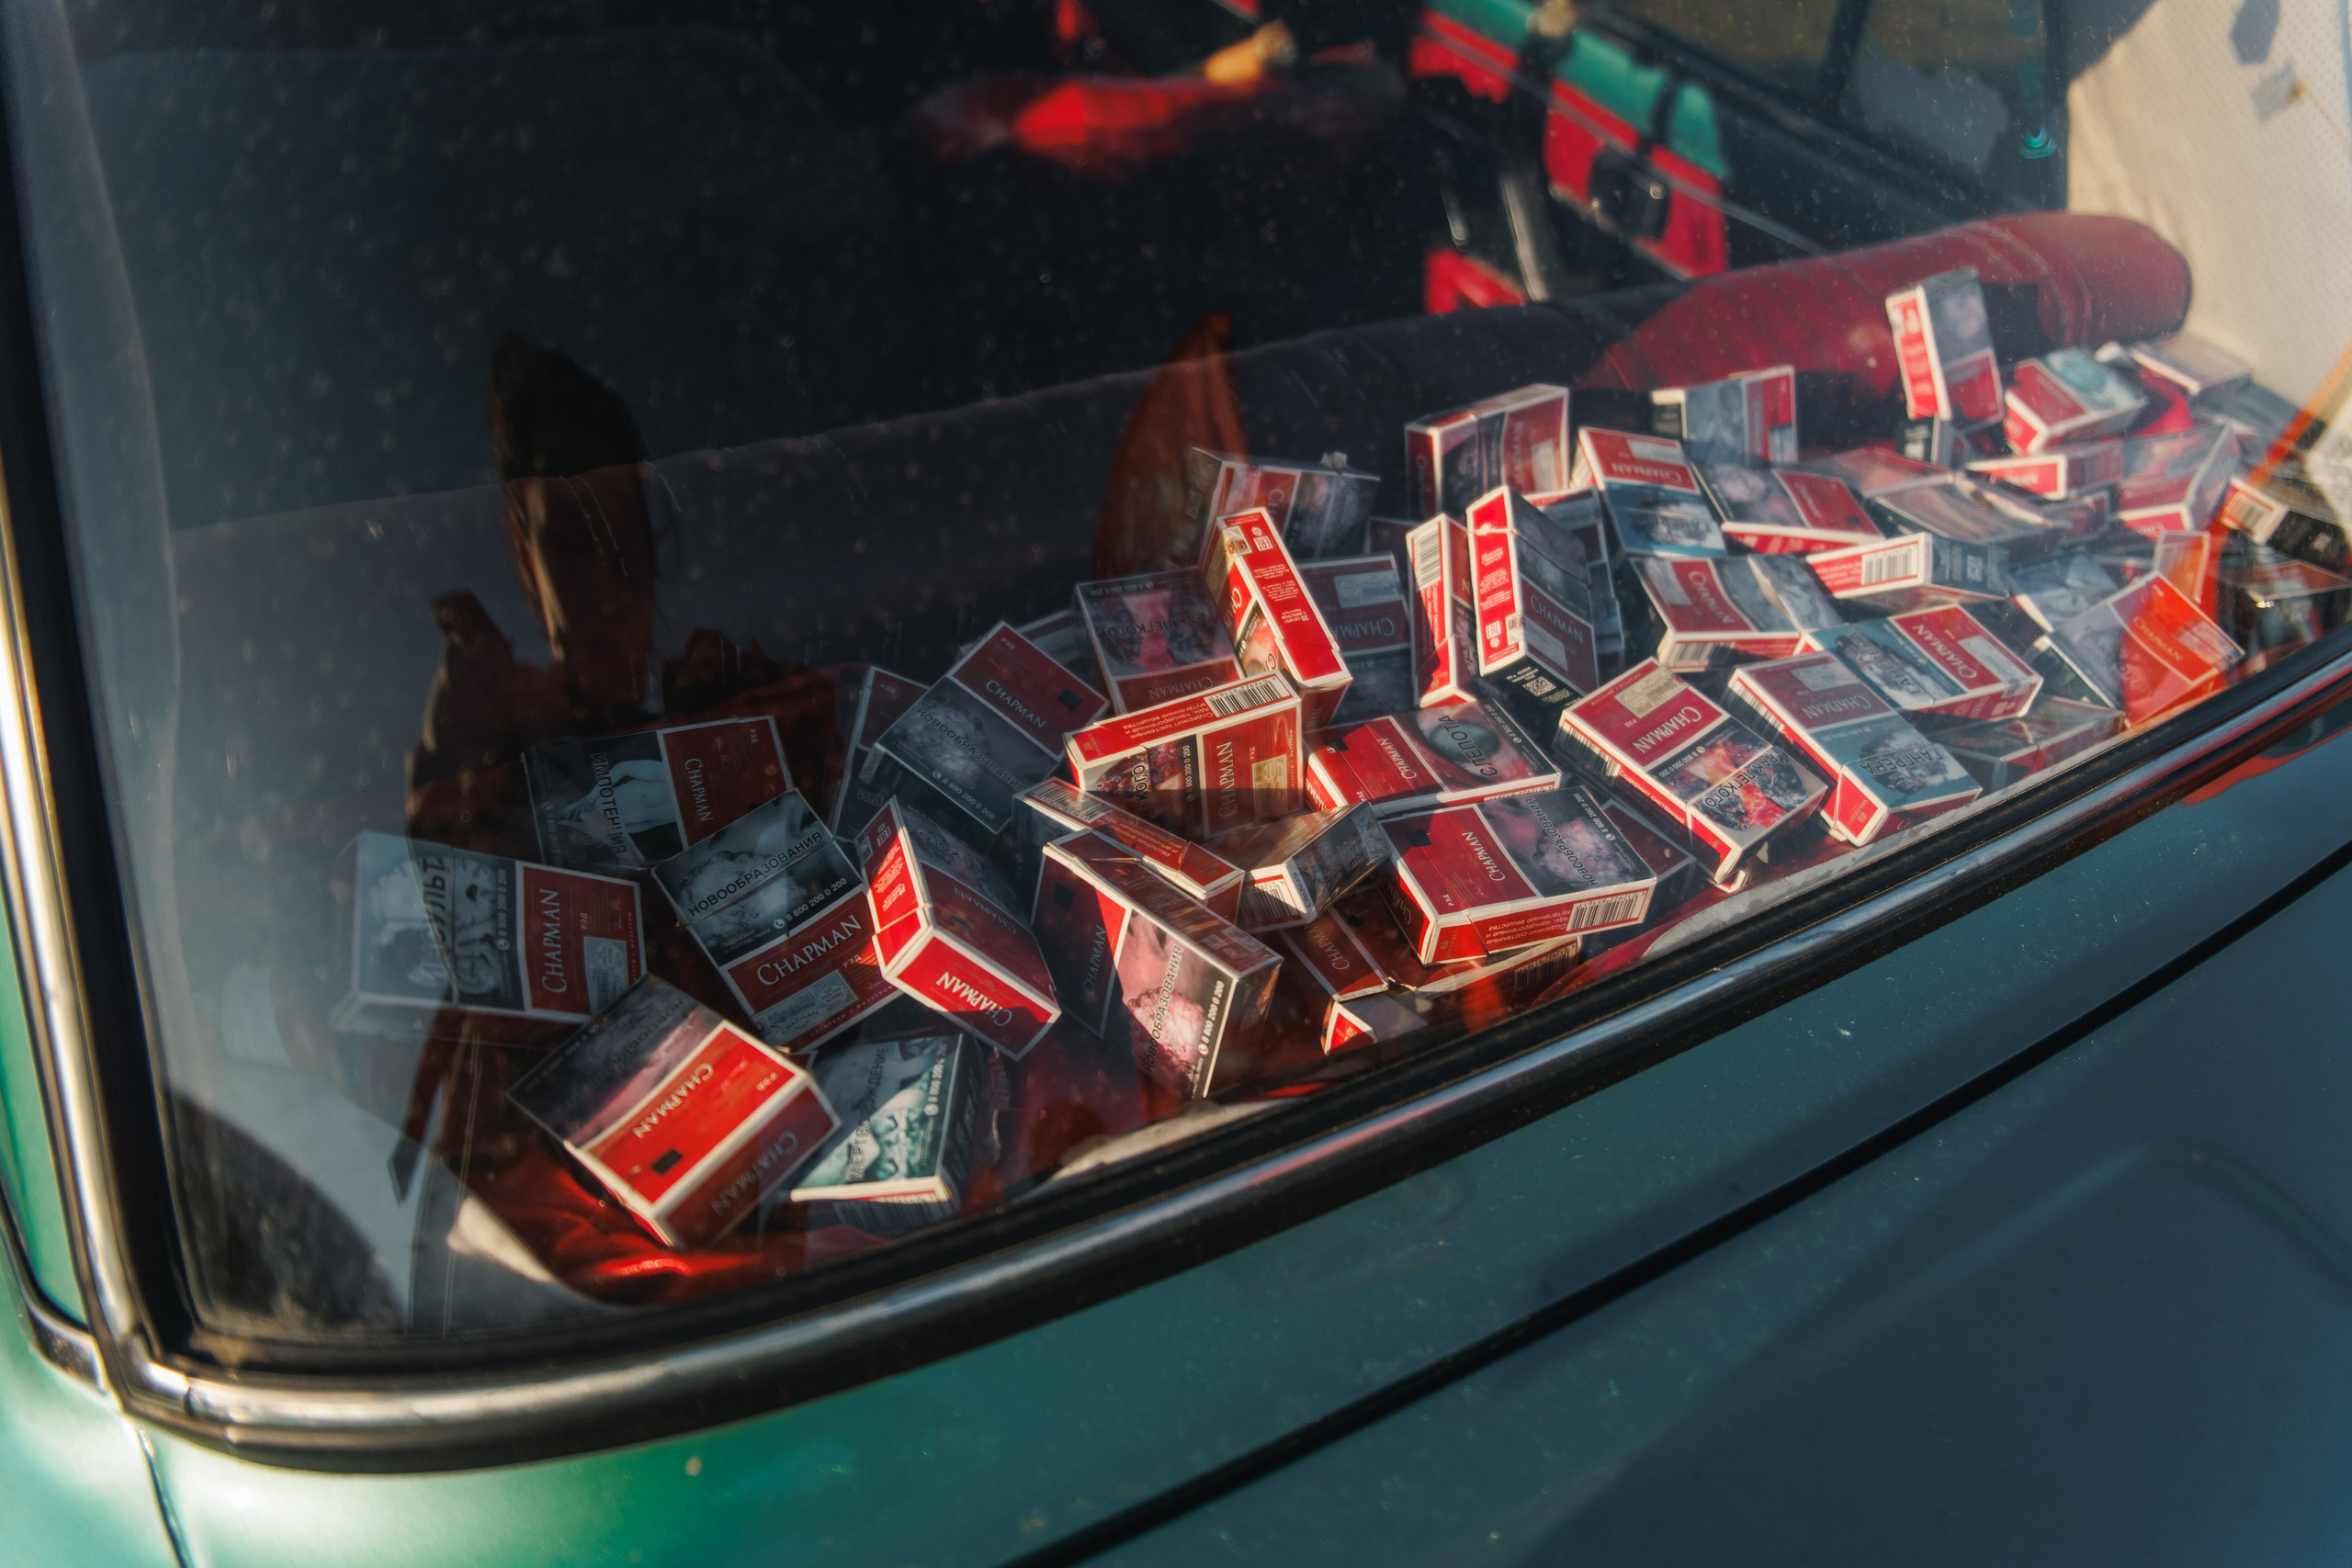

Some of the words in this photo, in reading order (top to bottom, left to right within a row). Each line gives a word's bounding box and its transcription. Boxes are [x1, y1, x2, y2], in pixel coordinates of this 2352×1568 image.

[1611, 462, 1682, 484] CHAPMAN
[1254, 536, 1272, 551] EAC
[1108, 618, 1176, 637] ЛЕГКОГО
[1327, 615, 1396, 645] CHAPMA
[1530, 594, 1584, 644] CHAPMAN
[1001, 637, 1016, 650] РЭД
[1912, 624, 1978, 680] CHAPMAN
[1148, 676, 1214, 700] CHAPMAN
[985, 680, 1048, 729] CHAPMAN
[1159, 700, 1206, 717] мутагенные
[1190, 705, 1210, 716] яды,
[1801, 694, 1872, 720] CHAPMAN
[1121, 715, 1161, 730] вещества
[1128, 711, 1191, 734] канцерогенные
[1170, 709, 1214, 726] Содержит
[1623, 718, 1638, 728] РЭД
[749, 728, 760, 743] РЭД
[1128, 723, 1173, 739] системные
[1632, 705, 1702, 754] CHAPMAN
[915, 707, 1027, 791] НОВООБРАЗОВАНИЯ
[1438, 715, 1498, 778] СЛЕПОТА
[1377, 737, 1419, 781] CHAPMAN
[1668, 764, 1674, 773] 0
[1672, 759, 1685, 770] 200
[1683, 753, 1696, 764] 800
[1757, 753, 1779, 773] РАК
[1860, 748, 1944, 776] ГАНГРЕНА
[1216, 741, 1238, 818] CHAPMAN
[1657, 767, 1669, 778] 200
[684, 758, 713, 823] CHAPMAN
[941, 775, 949, 784] 8
[948, 780, 963, 795] 800
[962, 790, 978, 806] 200
[976, 800, 983, 809] 0
[980, 804, 997, 820] 200
[1572, 792, 1584, 806] 200
[1617, 768, 1652, 798] Содержит
[1649, 792, 1686, 825] системные
[1703, 769, 1758, 808] ЛЕГКОГО
[591, 752, 628, 853] ИМПОТЕНЦИЯ
[1580, 802, 1588, 810] 0
[1584, 807, 1597, 820] 200
[1592, 817, 1605, 830] 800
[1525, 797, 1600, 887] НОВООБРАЗОВАНИЯ
[1461, 830, 1507, 883] CHAPMAN
[688, 832, 823, 917] НОВООБРАЗОВАНИЯ
[793, 904, 808, 918] 800
[808, 892, 825, 907] 200
[825, 887, 831, 897] 0
[831, 877, 847, 892] 200
[1292, 872, 1312, 908] CHAPMAN
[1442, 893, 1455, 908] РЭД
[581, 912, 589, 930] РЭД
[1487, 918, 1525, 931] вещества
[1525, 908, 1571, 923] мутагенные
[1485, 931, 1527, 946] системные
[1491, 919, 1551, 937] канцерогенные
[1527, 921, 1567, 937] Содержит
[539, 888, 568, 993] CHAPMAN
[756, 914, 862, 987] CHAPMAN
[842, 953, 862, 968] РЭД
[1081, 925, 1107, 996] CHAPMAN
[936, 971, 1012, 1027] CHAPMAN
[1144, 945, 1182, 1074] НОВООБРАЗОВАНИЯ
[632, 1062, 714, 1139] CHAPMAN
[710, 1130, 799, 1215] CHAPMAN
